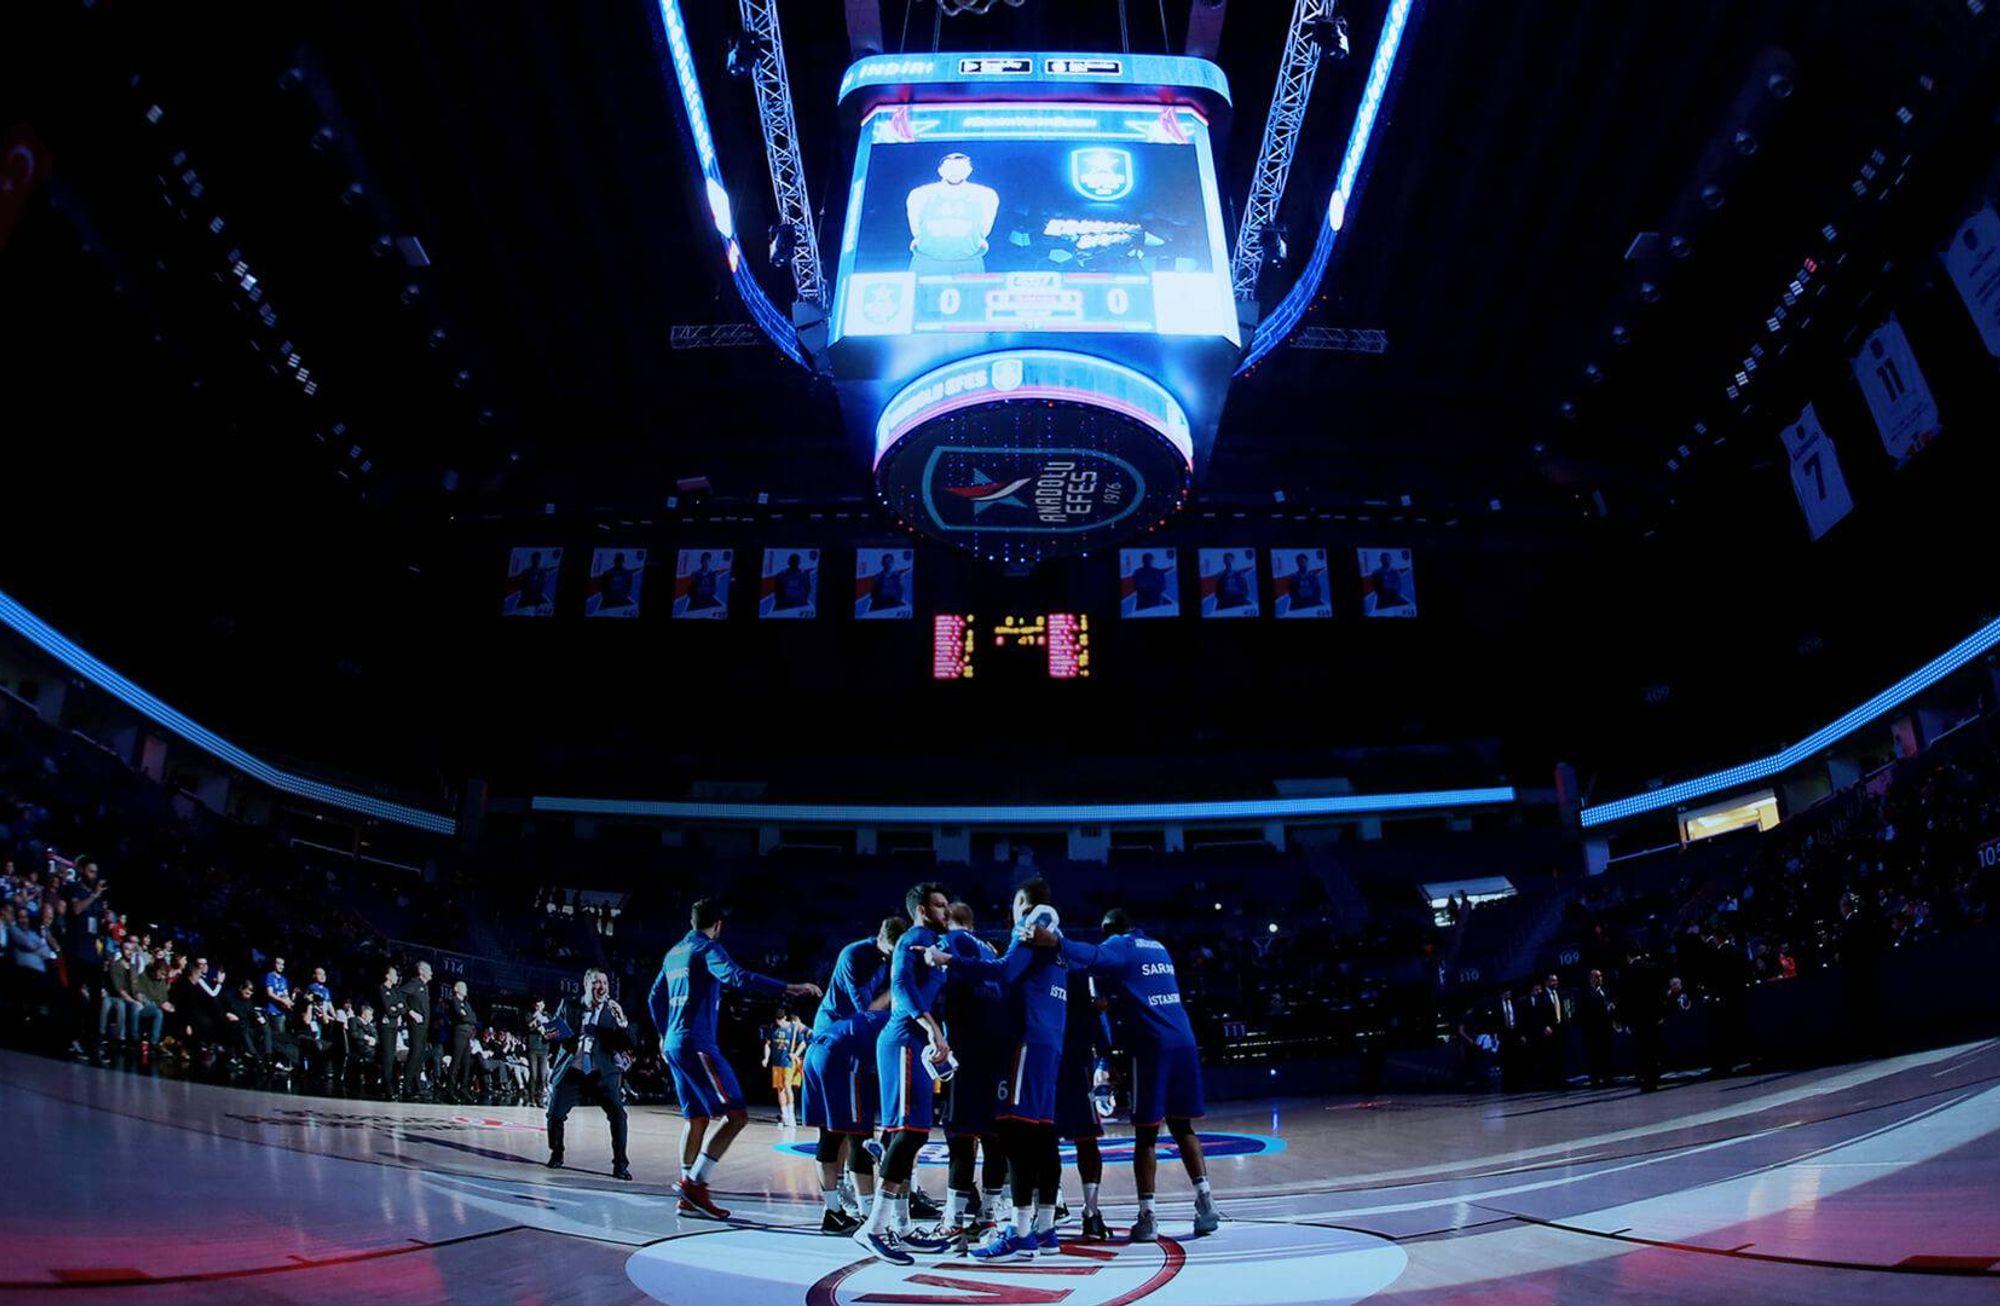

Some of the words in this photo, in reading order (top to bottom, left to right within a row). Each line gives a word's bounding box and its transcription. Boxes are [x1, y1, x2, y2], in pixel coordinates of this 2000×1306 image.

[940, 288, 961, 315] 0
[1107, 288, 1128, 315] 0
[1876, 358, 1905, 403] 11
[1034, 461, 1076, 522] ANADOLU
[1065, 471, 1098, 514] EFES
[1102, 481, 1122, 504] 1976
[1803, 451, 1826, 501] 7
[997, 1080, 1009, 1101] 6
